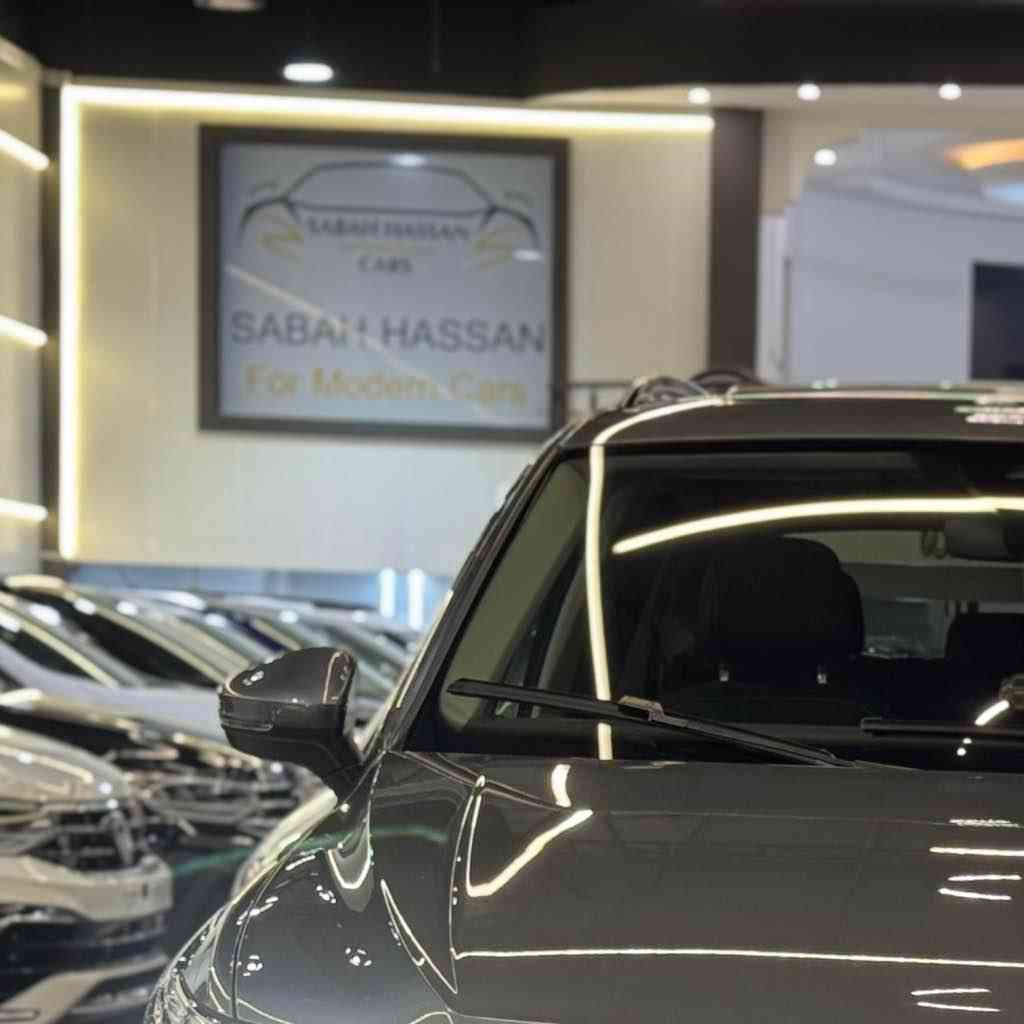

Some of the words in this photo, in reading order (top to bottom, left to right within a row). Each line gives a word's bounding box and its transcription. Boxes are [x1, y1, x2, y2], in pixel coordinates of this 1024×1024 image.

[308, 214, 379, 239] SABAH
[231, 310, 368, 349] SABAH
[381, 316, 545, 354] HASSAN
[244, 363, 300, 396] For
[449, 371, 528, 408] Cars
